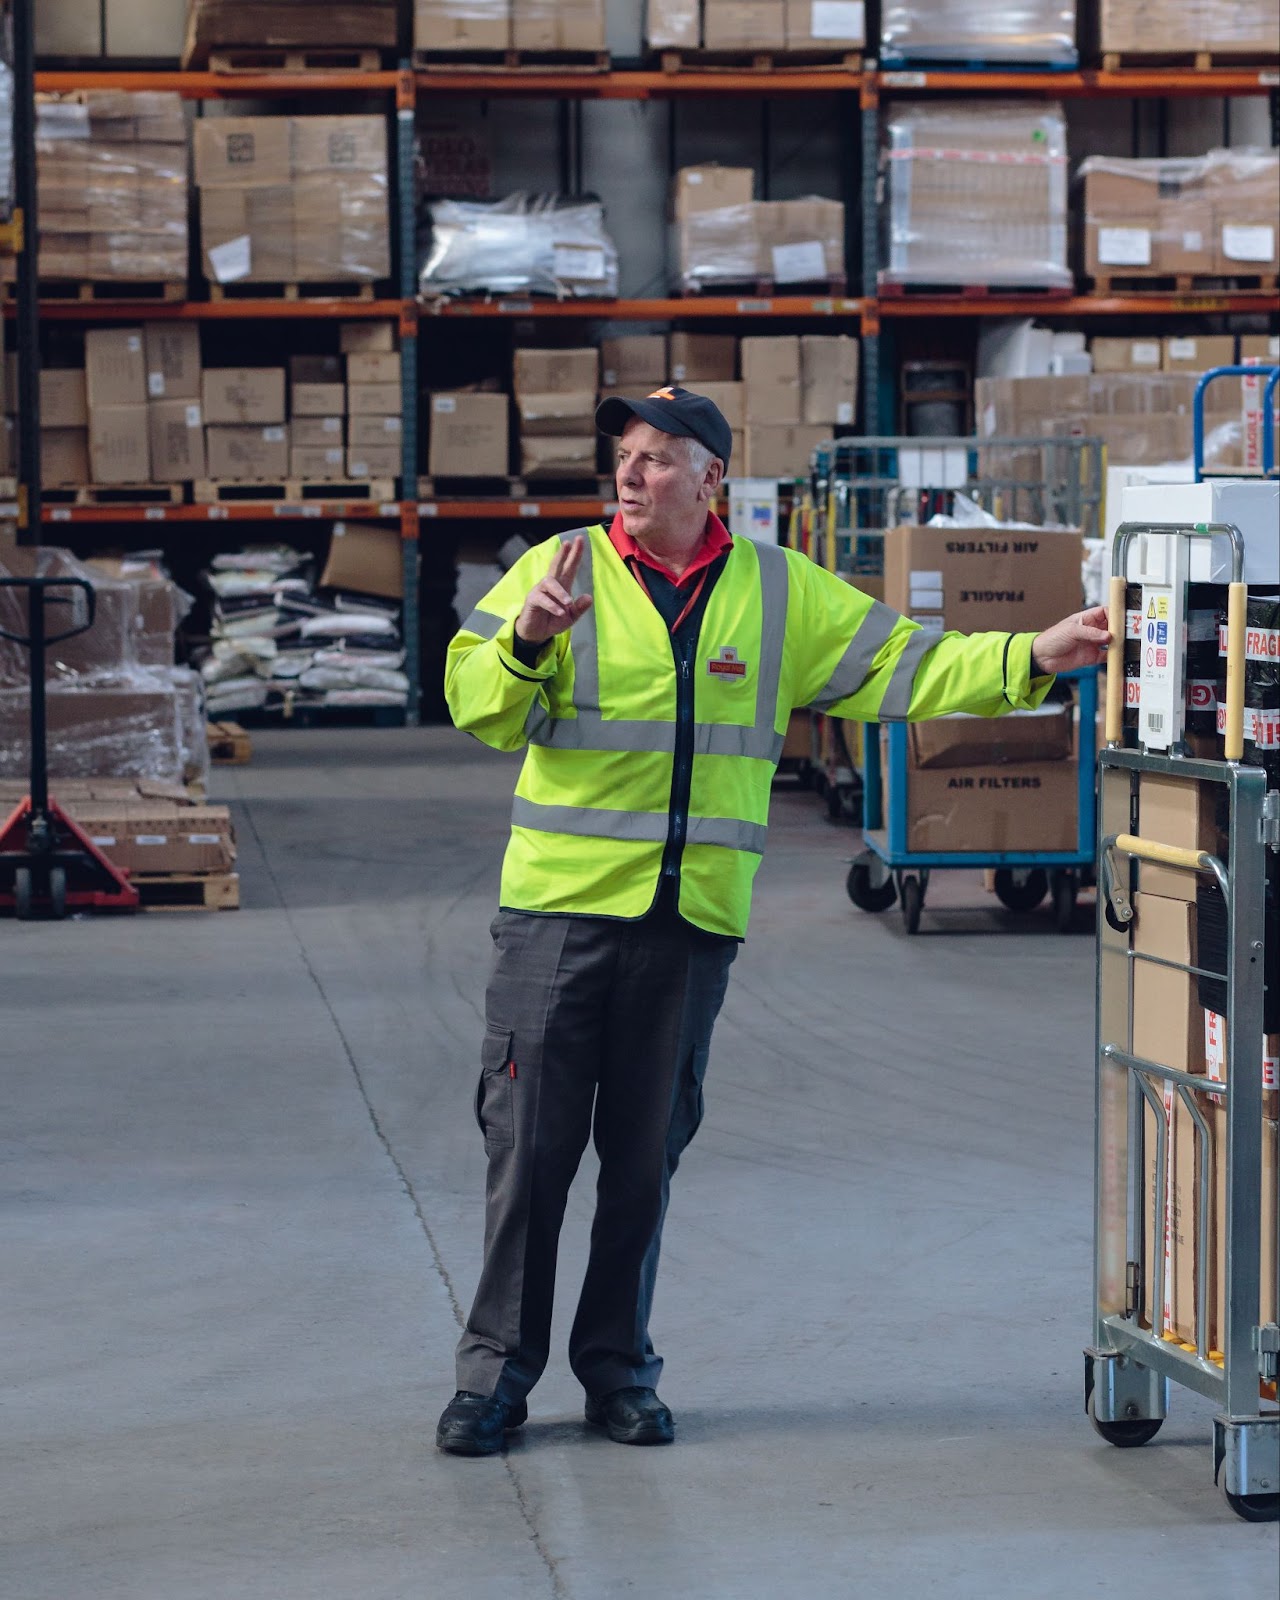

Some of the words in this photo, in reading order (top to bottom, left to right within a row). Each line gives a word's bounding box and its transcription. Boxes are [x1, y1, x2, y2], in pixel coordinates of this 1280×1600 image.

[946, 541, 1009, 553] FILTERS
[1013, 541, 1039, 553] AIR
[960, 590, 1024, 602] FRAGILE
[948, 777, 974, 788] AIR
[979, 777, 1042, 788] FILTERS
